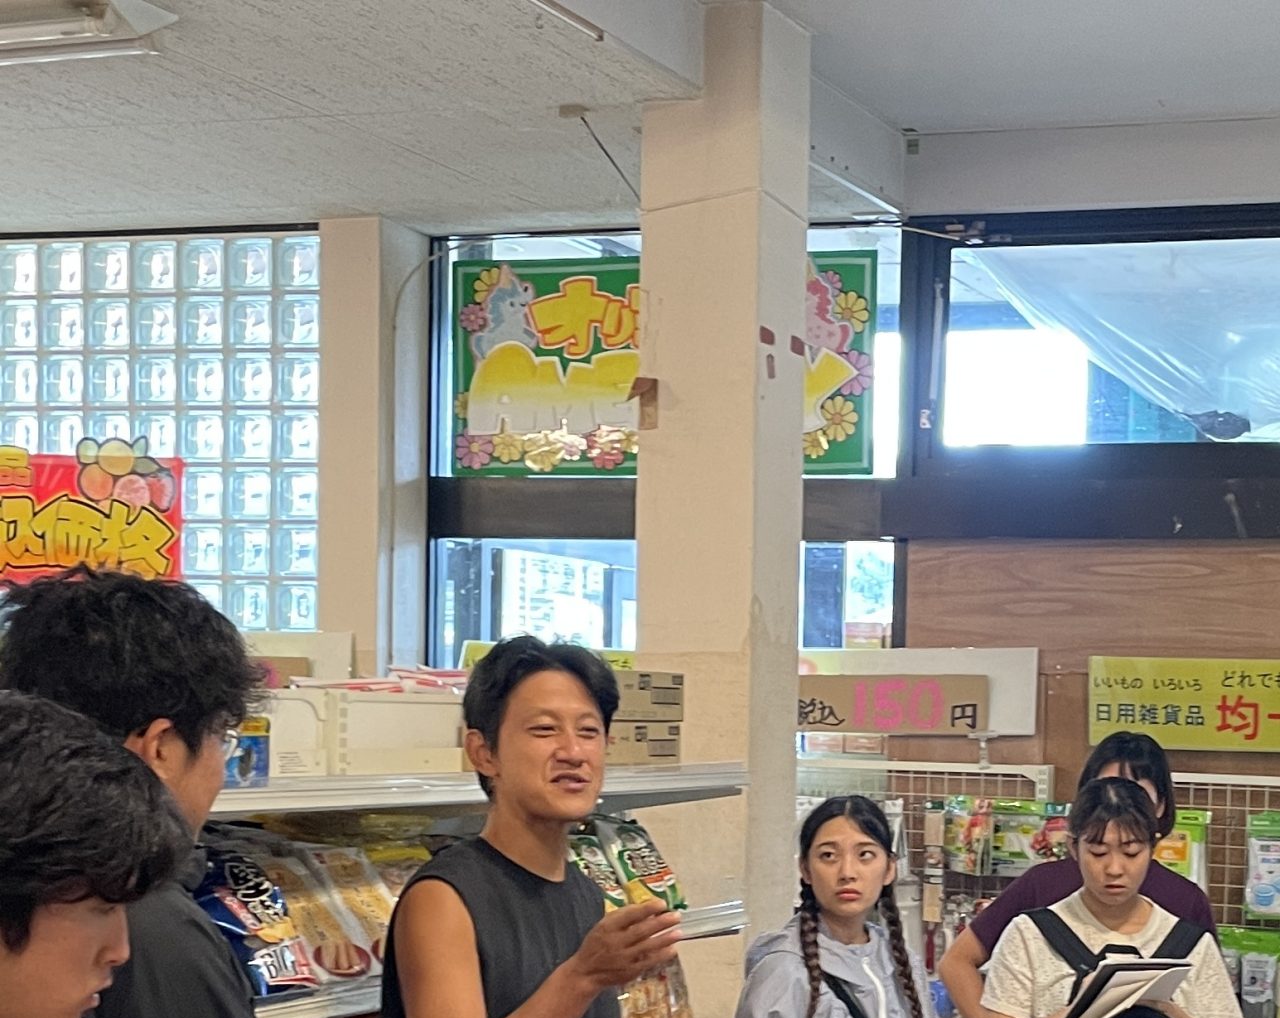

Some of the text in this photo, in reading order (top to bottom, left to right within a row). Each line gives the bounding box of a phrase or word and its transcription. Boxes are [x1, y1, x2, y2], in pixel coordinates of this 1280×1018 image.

[1094, 676, 1203, 692] いいもの いろいろ
[1095, 702, 1205, 727] 日用雑貨品
